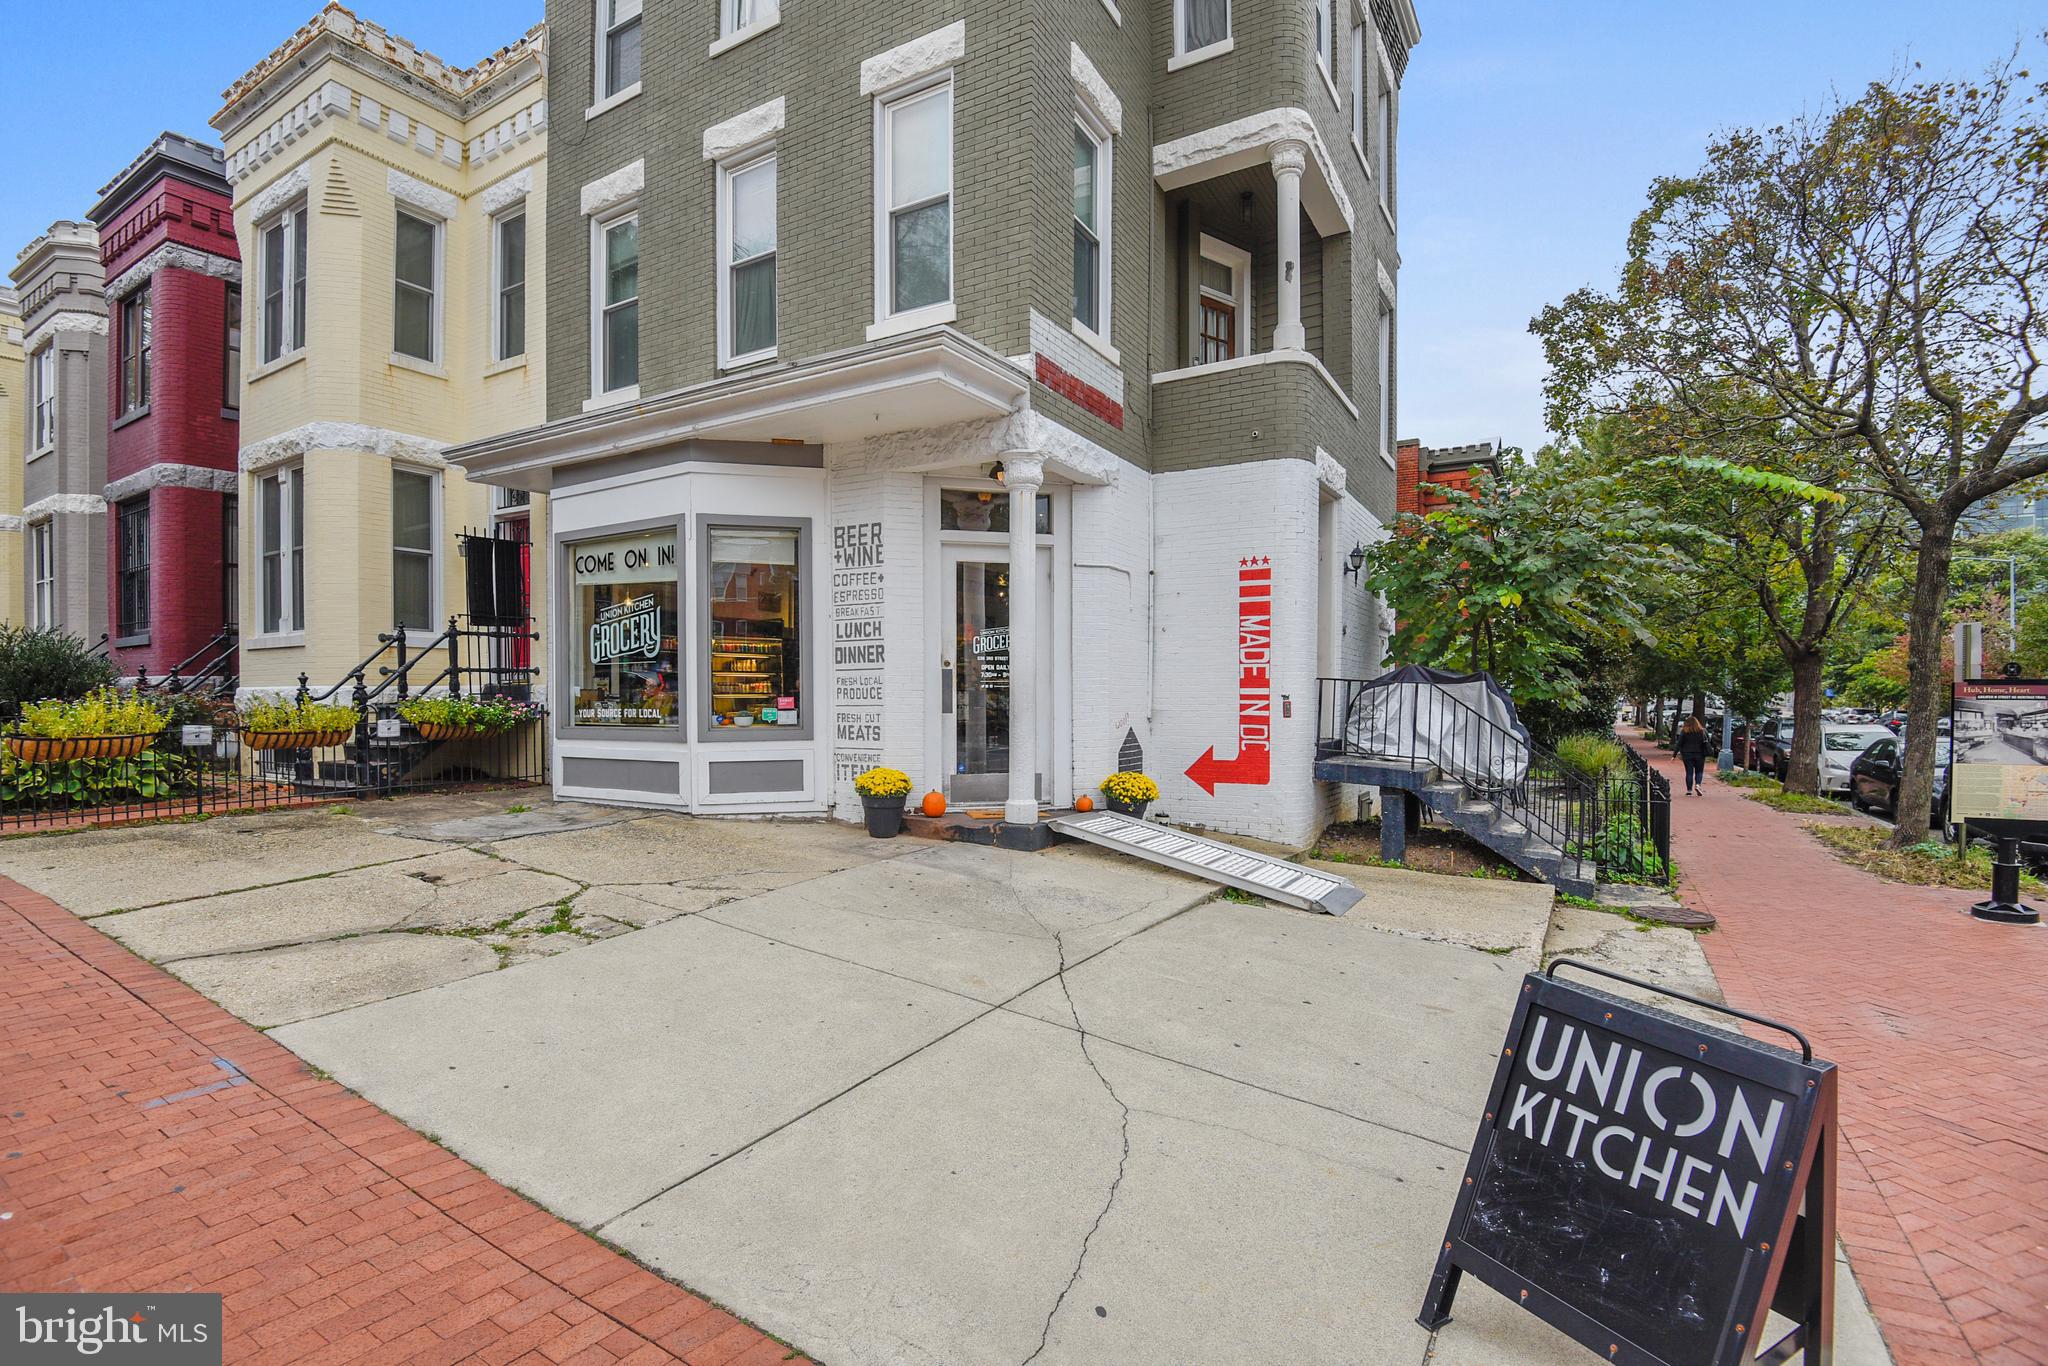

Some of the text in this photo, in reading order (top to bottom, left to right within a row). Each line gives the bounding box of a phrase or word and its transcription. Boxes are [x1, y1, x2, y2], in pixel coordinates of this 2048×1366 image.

[833, 522, 882, 549] BEER
[575, 544, 675, 574] COME ON IN!
[833, 588, 884, 603] ESPRESSO
[600, 598, 654, 620] UNION KITCHEN
[835, 606, 881, 617] BREAKFAST
[590, 605, 660, 664] GROCERY
[836, 621, 882, 639] LUNCH
[973, 634, 1009, 654] GROCER
[834, 644, 885, 664] DINNER
[836, 675, 883, 686] FRESH LOCAL
[1239, 615, 1271, 752] MADE IN DC
[836, 687, 883, 700] PRODUCE
[1963, 686, 1982, 694] Hub,
[1983, 686, 2008, 694] Home,
[578, 709, 661, 718] YOUR SOURCE FOR LOCAL
[836, 713, 881, 723] FRESH CUT
[836, 724, 881, 741] MEATS
[836, 753, 881, 762] CONVENIENCE
[836, 763, 881, 781] ITEM
[1525, 1014, 1784, 1175] UNION
[1507, 1083, 1758, 1239] KITCHEN
